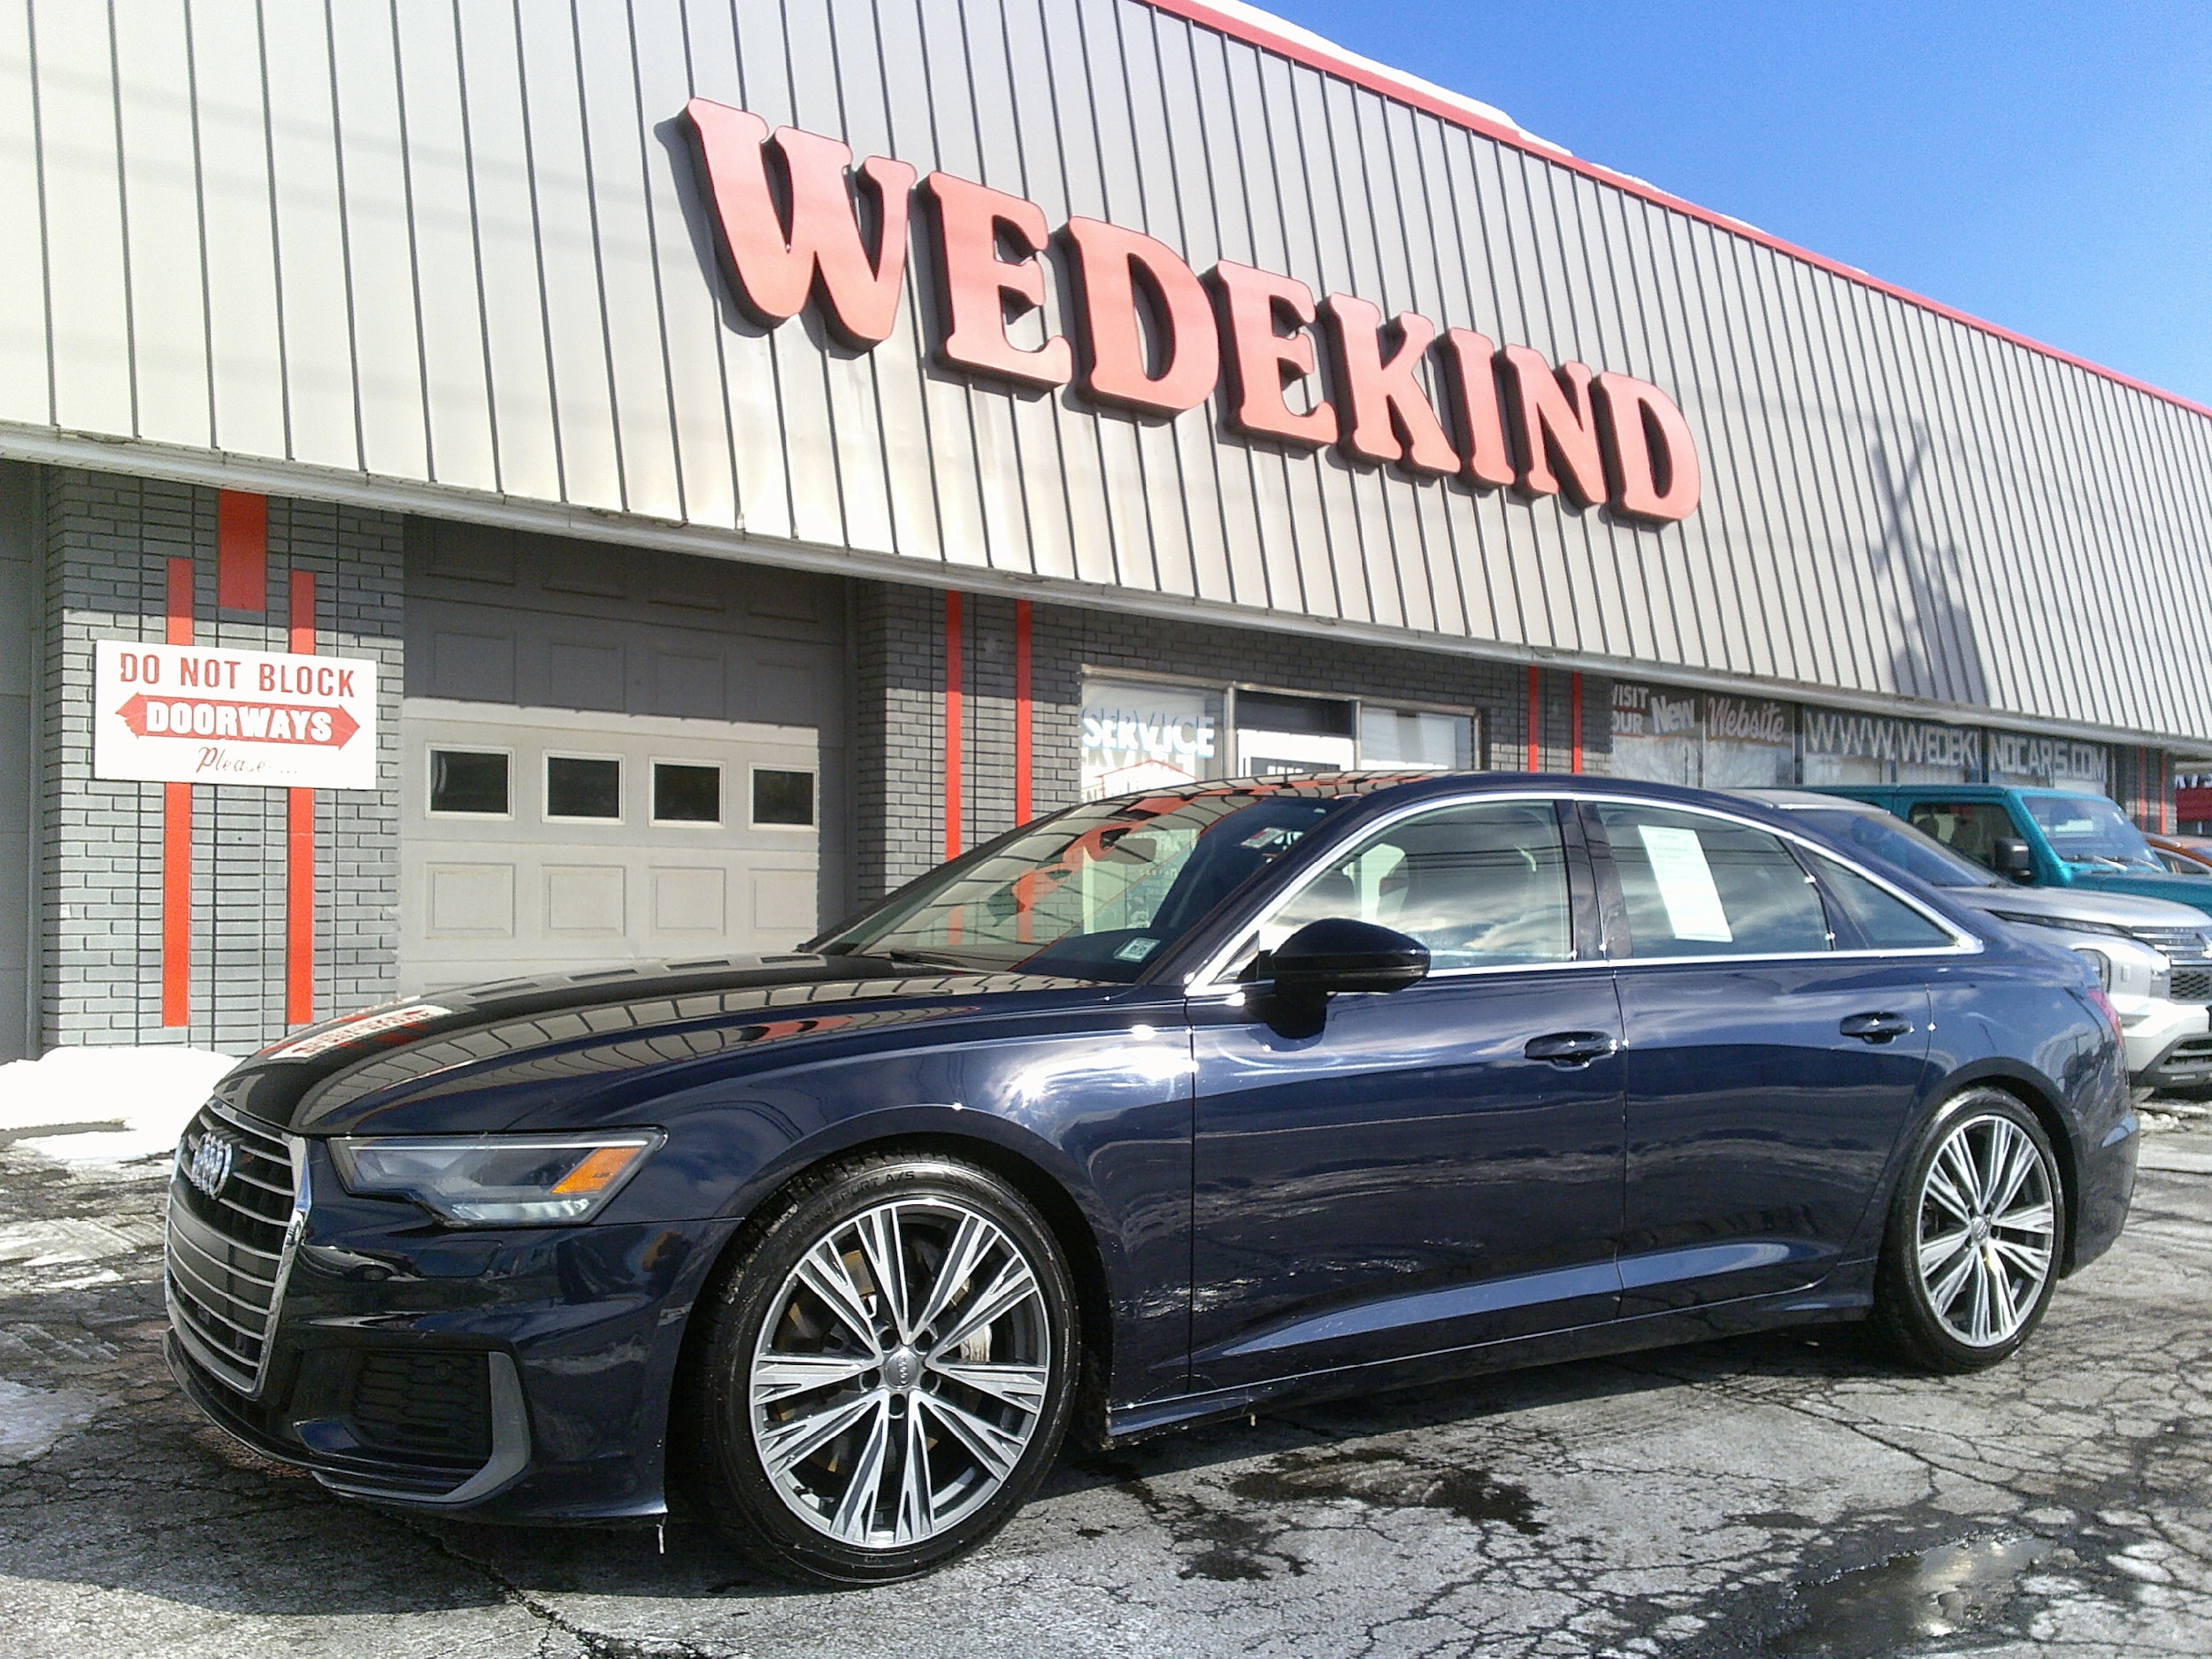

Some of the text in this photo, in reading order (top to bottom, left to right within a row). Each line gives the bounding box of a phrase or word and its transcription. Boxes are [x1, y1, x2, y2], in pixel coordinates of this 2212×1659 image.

[685, 97, 1701, 523] WEDEKIND
[120, 653, 355, 697] DO NOT BLOCK
[145, 701, 333, 742] DOORWAYS
[1081, 708, 1215, 759] SERVICE
